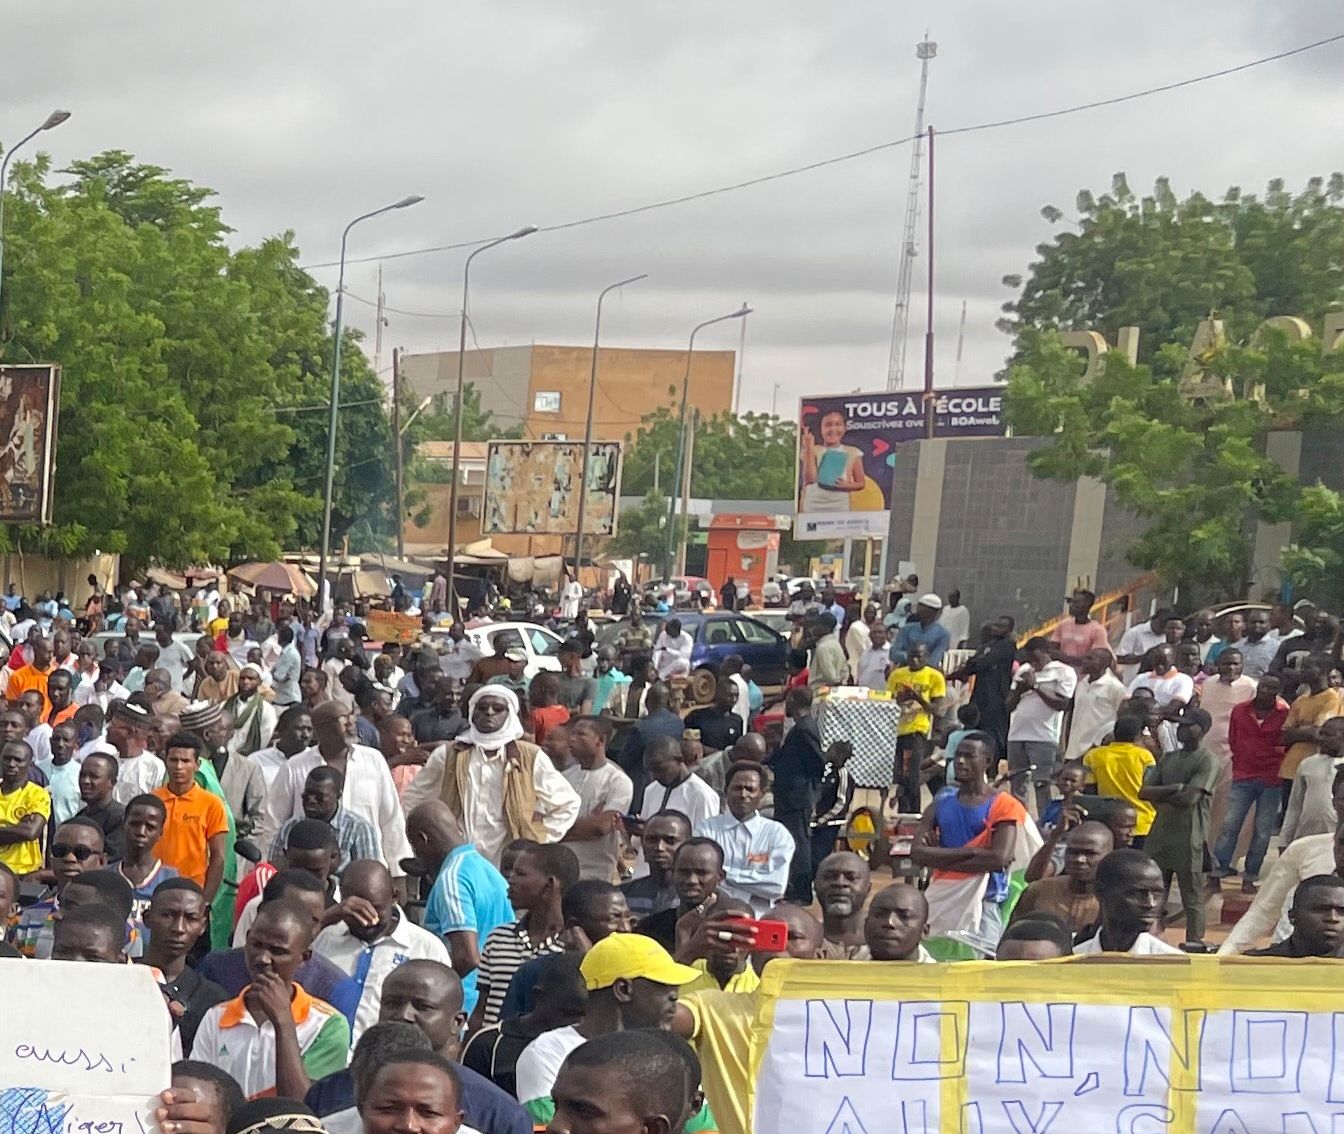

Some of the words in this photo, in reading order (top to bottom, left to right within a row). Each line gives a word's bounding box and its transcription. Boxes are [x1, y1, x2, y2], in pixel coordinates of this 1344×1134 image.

[844, 401, 898, 418] TOUS
[902, 396, 917, 416] À
[922, 395, 1002, 414] ÉCOLE
[905, 419, 925, 428] ave
[15, 1043, 136, 1074] aussi
[1124, 1005, 1344, 1103] NO
